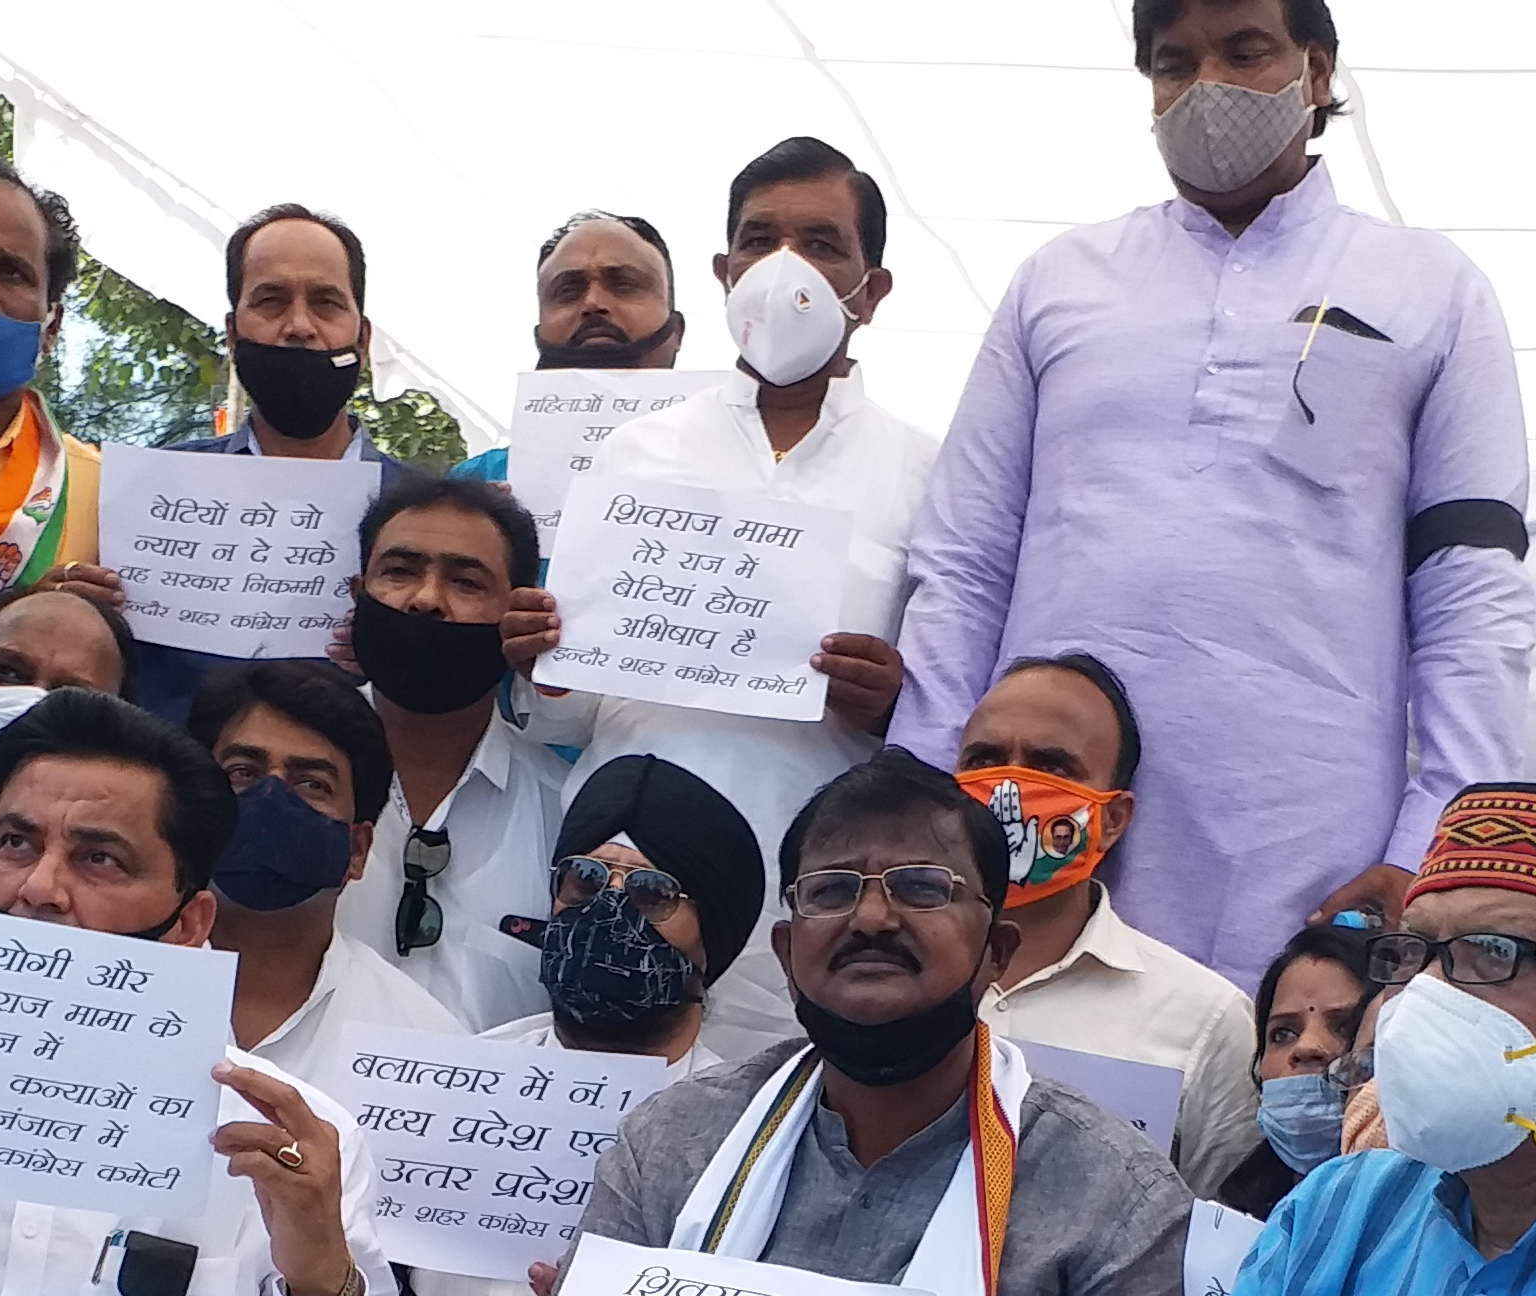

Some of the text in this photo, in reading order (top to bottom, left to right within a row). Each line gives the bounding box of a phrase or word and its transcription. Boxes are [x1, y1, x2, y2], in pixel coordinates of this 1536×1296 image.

[524, 393, 604, 414] महिलाओं
[150, 494, 325, 530] बेटियों को जो
[602, 494, 804, 550] शिवराज मामा
[134, 534, 338, 565] न्याय न दे सके
[632, 538, 760, 580] तेरे राज में
[117, 565, 150, 583] वह
[160, 571, 234, 592] सरकार
[242, 573, 325, 596] निकम्मी
[612, 570, 772, 619] बेटियां होना
[124, 600, 171, 618] न्दौर
[178, 609, 221, 626] शहर
[230, 611, 292, 630] कांग्रेस
[613, 614, 757, 657] अभिषाप है
[552, 645, 807, 696] इन्दौर शहर कांग्रेस कमेटी
[86, 960, 154, 993] और
[64, 1002, 137, 1033] मामा
[148, 1010, 187, 1039] के
[33, 1031, 66, 1061] में
[352, 1051, 506, 1094] बलात्कार
[519, 1066, 554, 1102] में
[9, 1073, 137, 1113] कन्याओं
[148, 1094, 195, 1119] का
[97, 1121, 130, 1149] में
[356, 1103, 436, 1137] मध्य
[448, 1110, 553, 1152] प्रदेश
[96, 1161, 182, 1193] कमेटी
[380, 1158, 594, 1206] उत्तर प्रदेश
[414, 1206, 468, 1226] शहर
[478, 1212, 550, 1238] कांग्रेस
